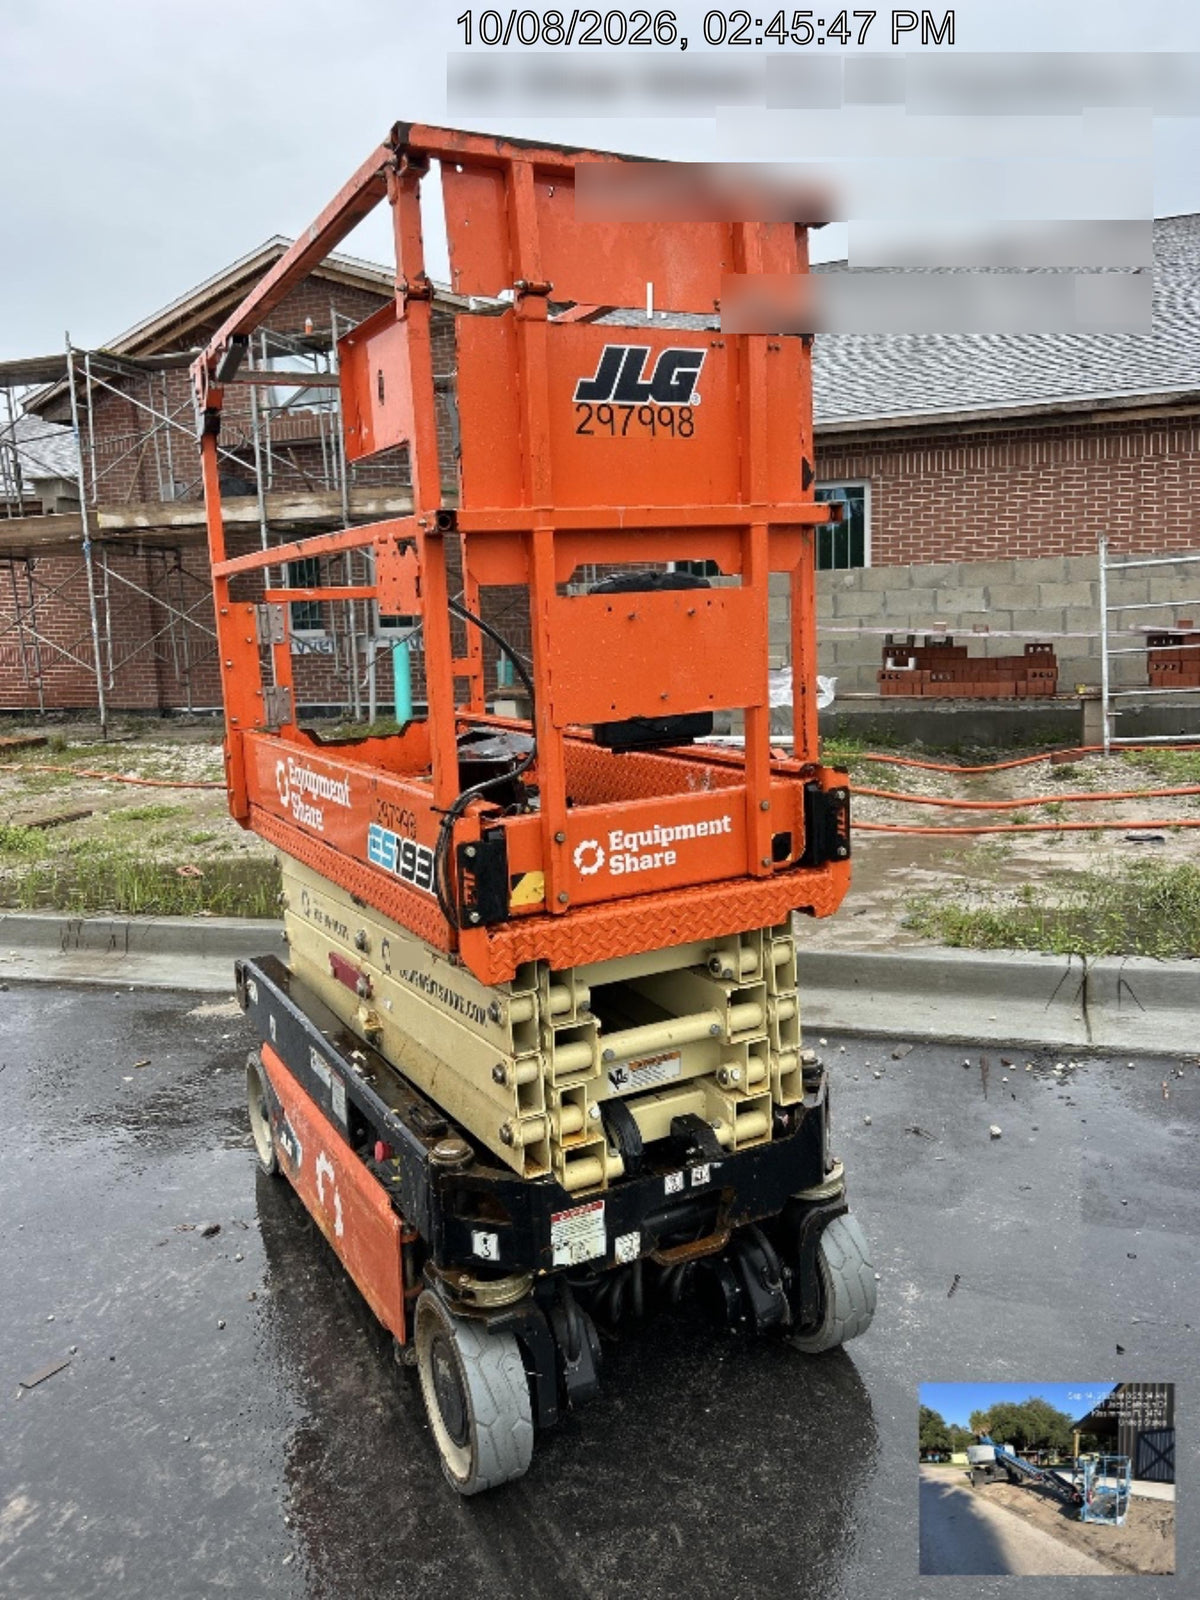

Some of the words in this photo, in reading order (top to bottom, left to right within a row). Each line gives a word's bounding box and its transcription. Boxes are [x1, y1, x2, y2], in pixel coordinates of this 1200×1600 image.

[572, 343, 708, 406] JLG
[575, 403, 694, 438] 297998
[287, 756, 352, 808] Equipment
[290, 791, 325, 832] Share
[608, 814, 732, 852] Equipment
[367, 821, 440, 897] ES193
[608, 849, 676, 875] Share
